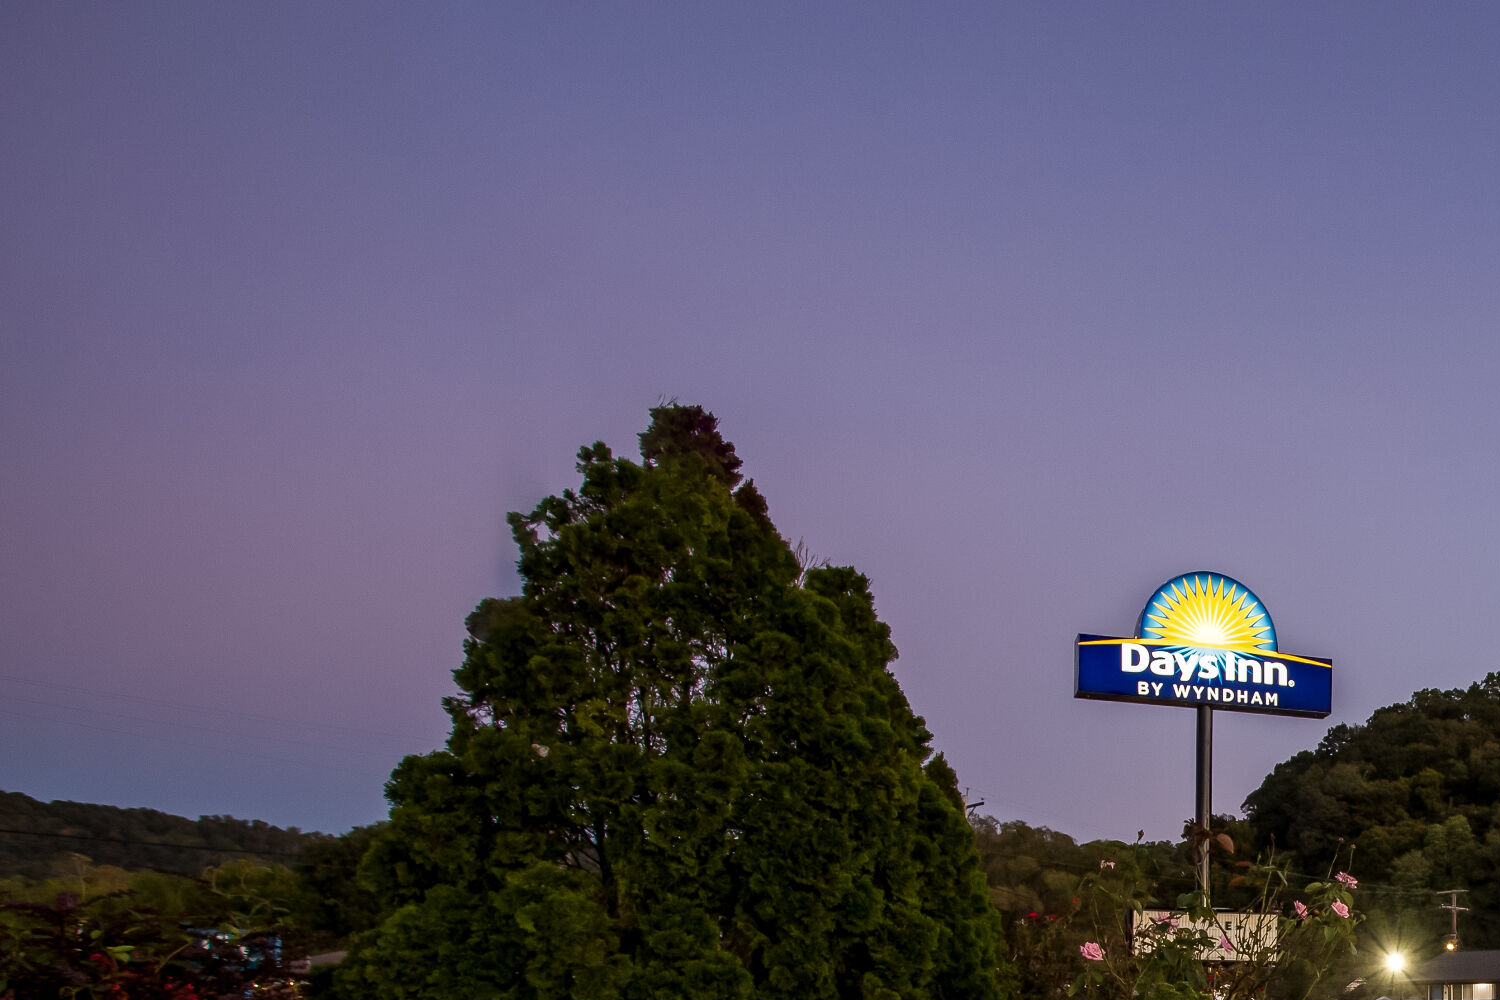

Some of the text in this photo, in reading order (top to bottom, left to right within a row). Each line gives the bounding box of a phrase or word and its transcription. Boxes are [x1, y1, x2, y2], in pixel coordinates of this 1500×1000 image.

[1121, 642, 1219, 682] Days
[1137, 680, 1279, 707] BY WYNDHAM
